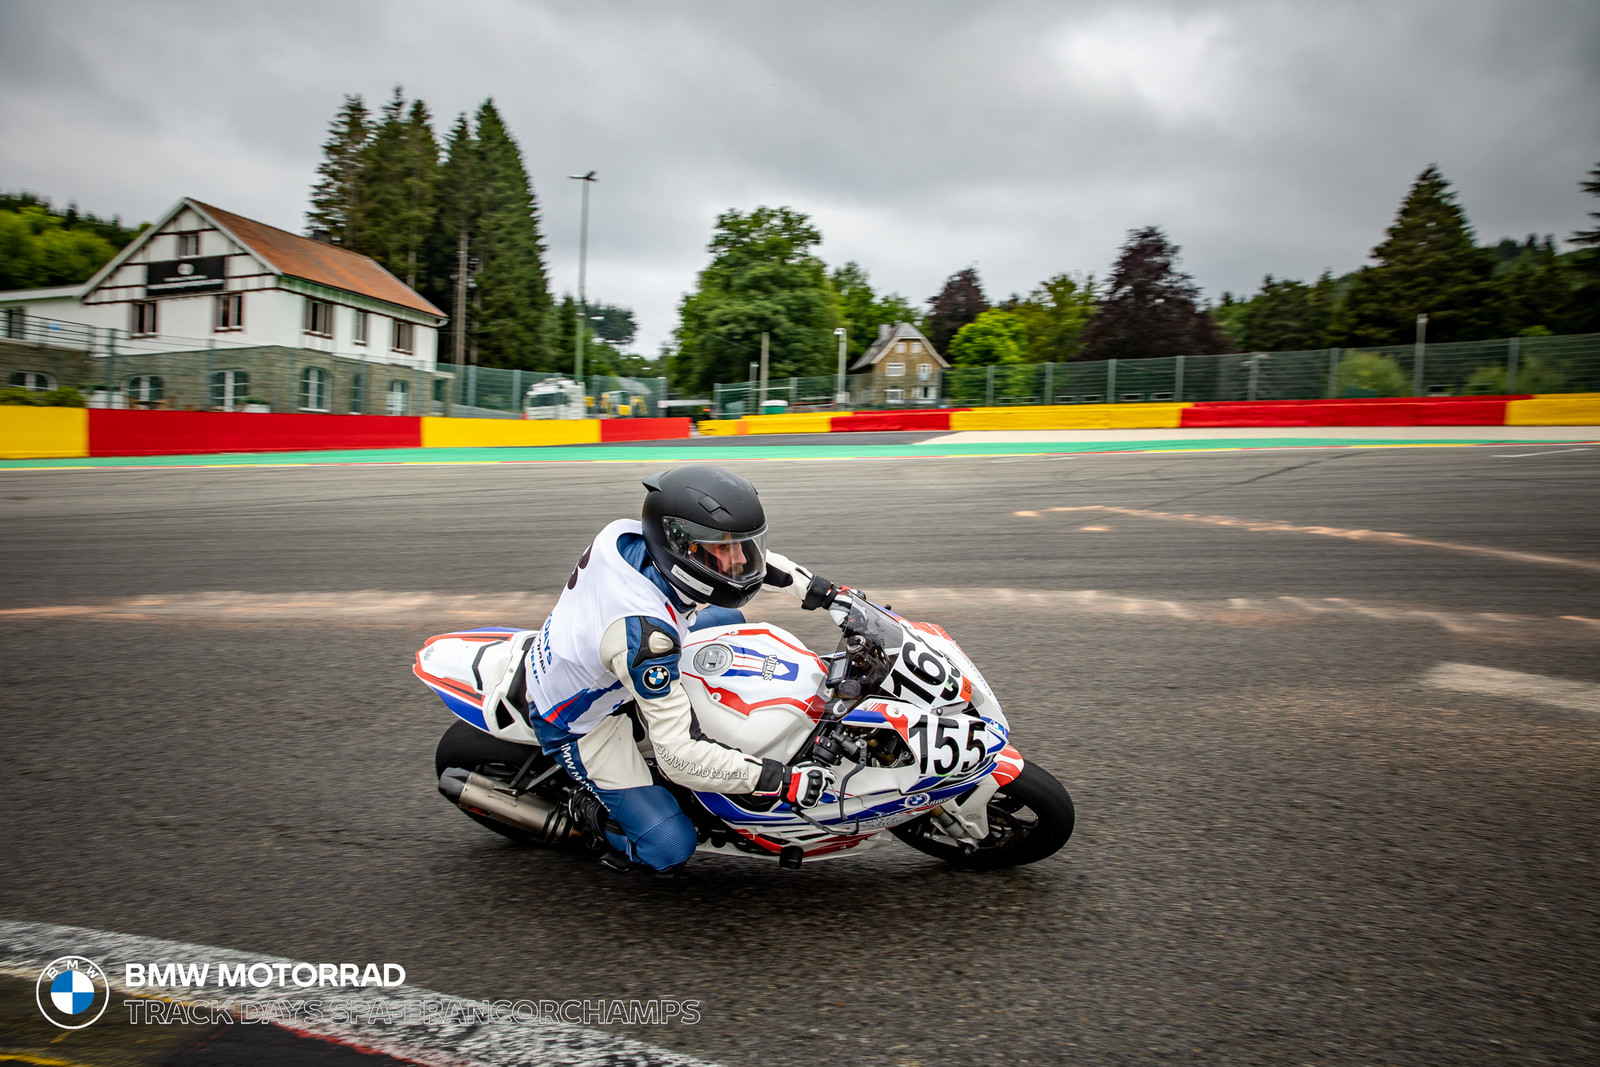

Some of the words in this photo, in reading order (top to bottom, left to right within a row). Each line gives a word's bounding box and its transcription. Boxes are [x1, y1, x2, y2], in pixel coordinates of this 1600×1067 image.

[655, 744, 690, 772] BMW
[687, 763, 749, 781] Motorrad
[908, 714, 987, 775] 155
